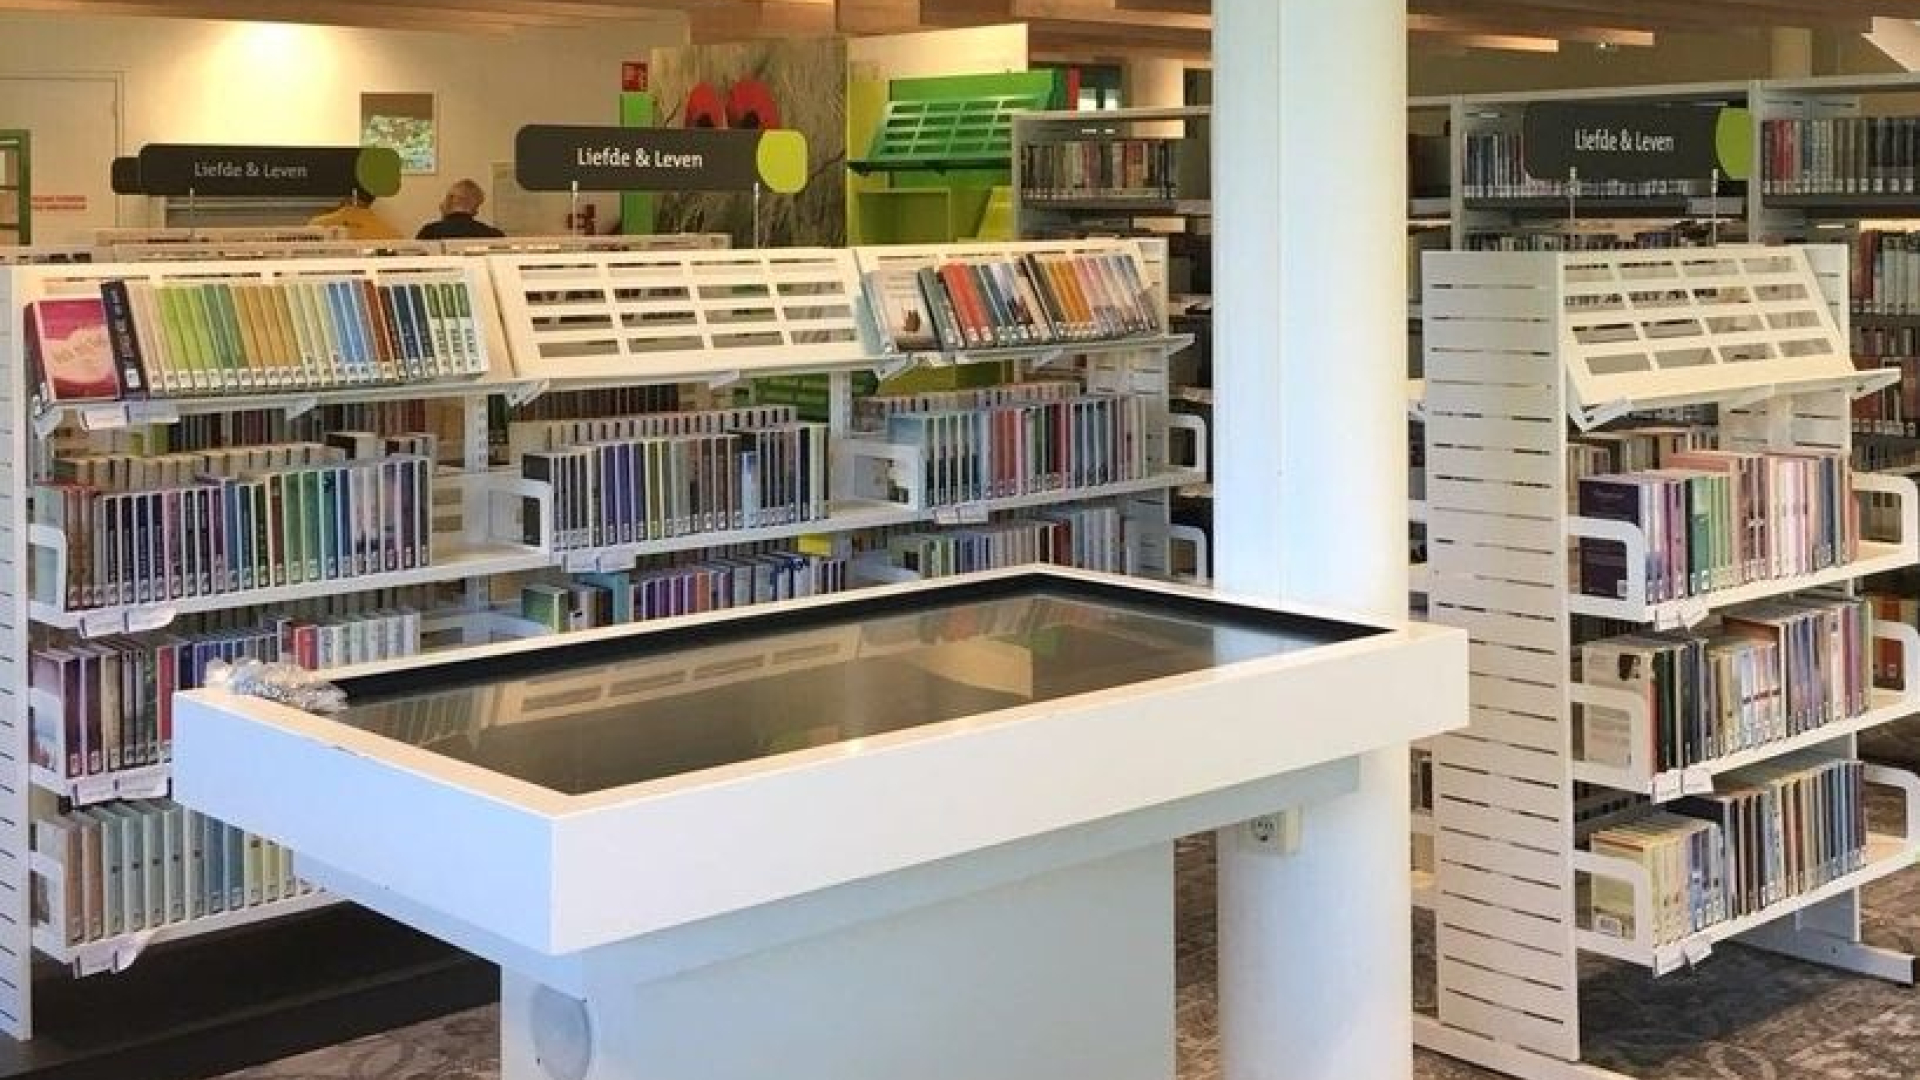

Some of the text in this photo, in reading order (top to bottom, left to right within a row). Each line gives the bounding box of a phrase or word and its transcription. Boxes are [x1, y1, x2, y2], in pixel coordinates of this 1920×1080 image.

[1575, 129, 1674, 152] Liefde & Leven
[577, 147, 703, 168] Liefde & Leven
[195, 161, 307, 178] Liefde & Leven
